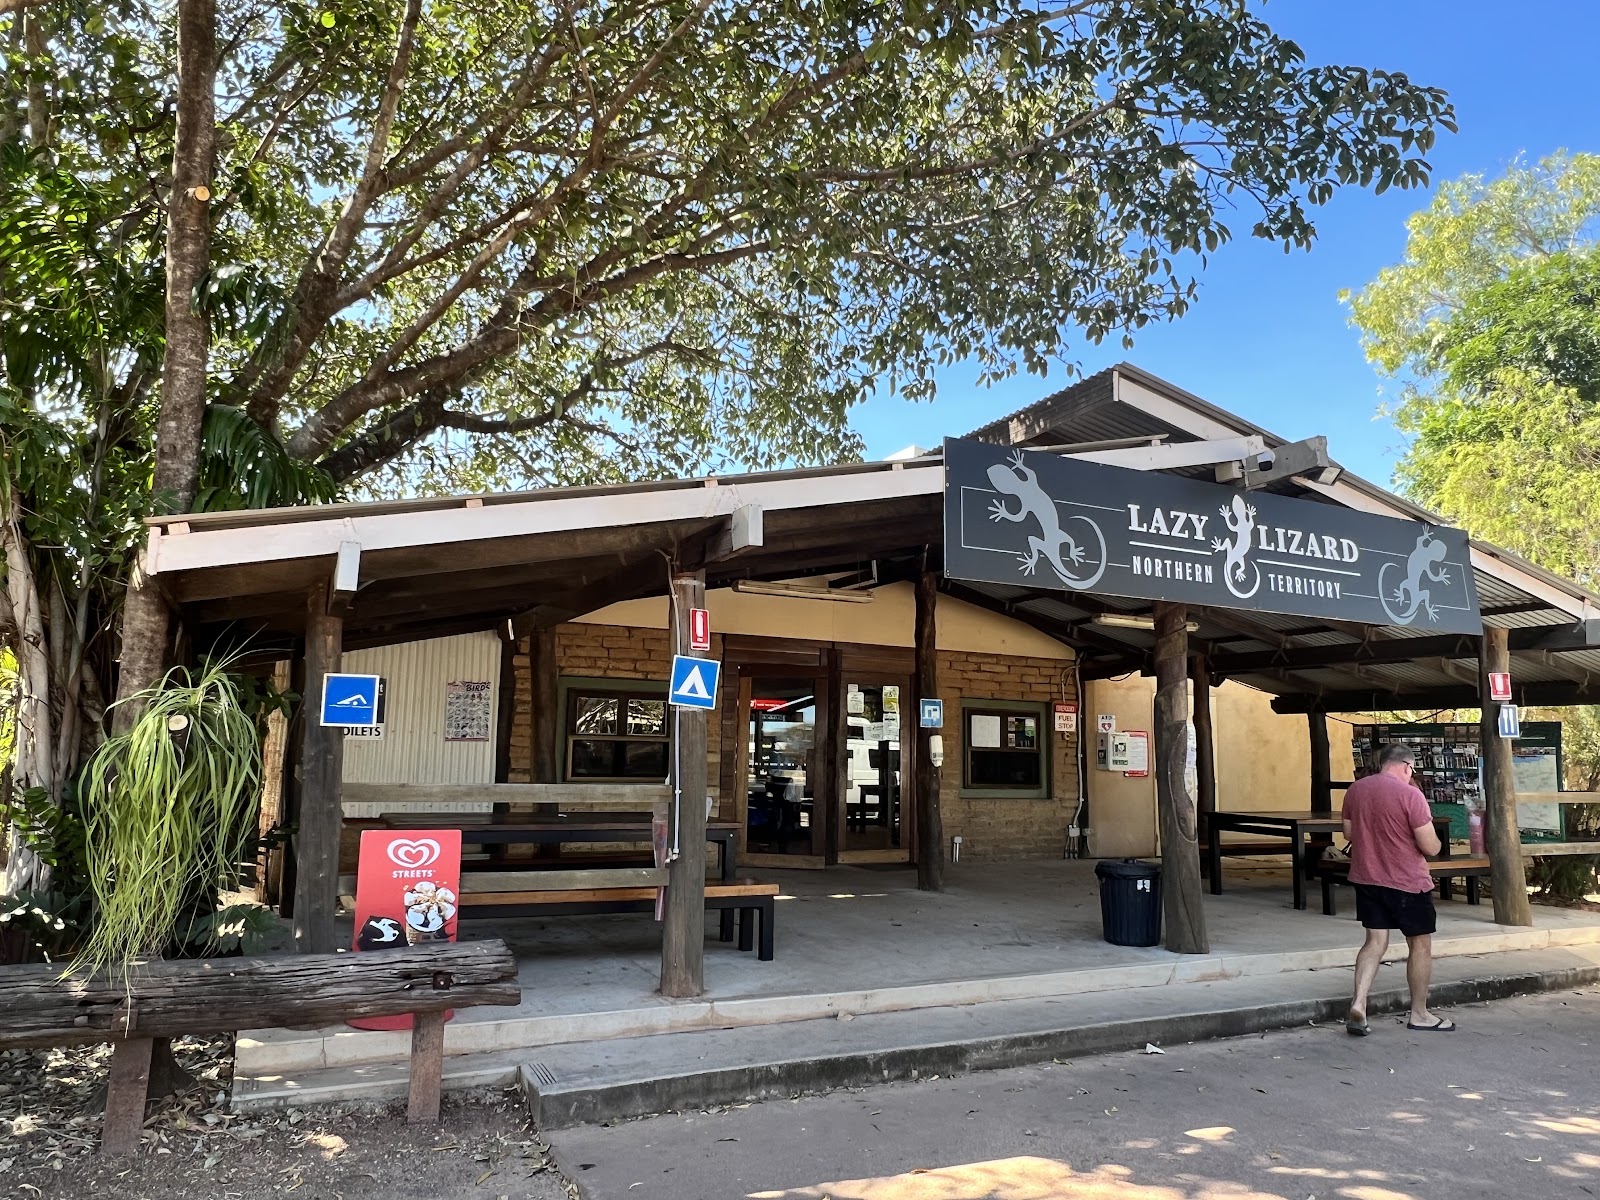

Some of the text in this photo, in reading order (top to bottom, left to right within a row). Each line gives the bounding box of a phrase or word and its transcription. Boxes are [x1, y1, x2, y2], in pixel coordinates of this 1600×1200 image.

[1127, 503, 1359, 563] LAZY LIZARD
[1132, 556, 1341, 600] NORTHERN TERRITORY
[343, 726, 381, 736] OILETS
[392, 869, 433, 879] STREETS
